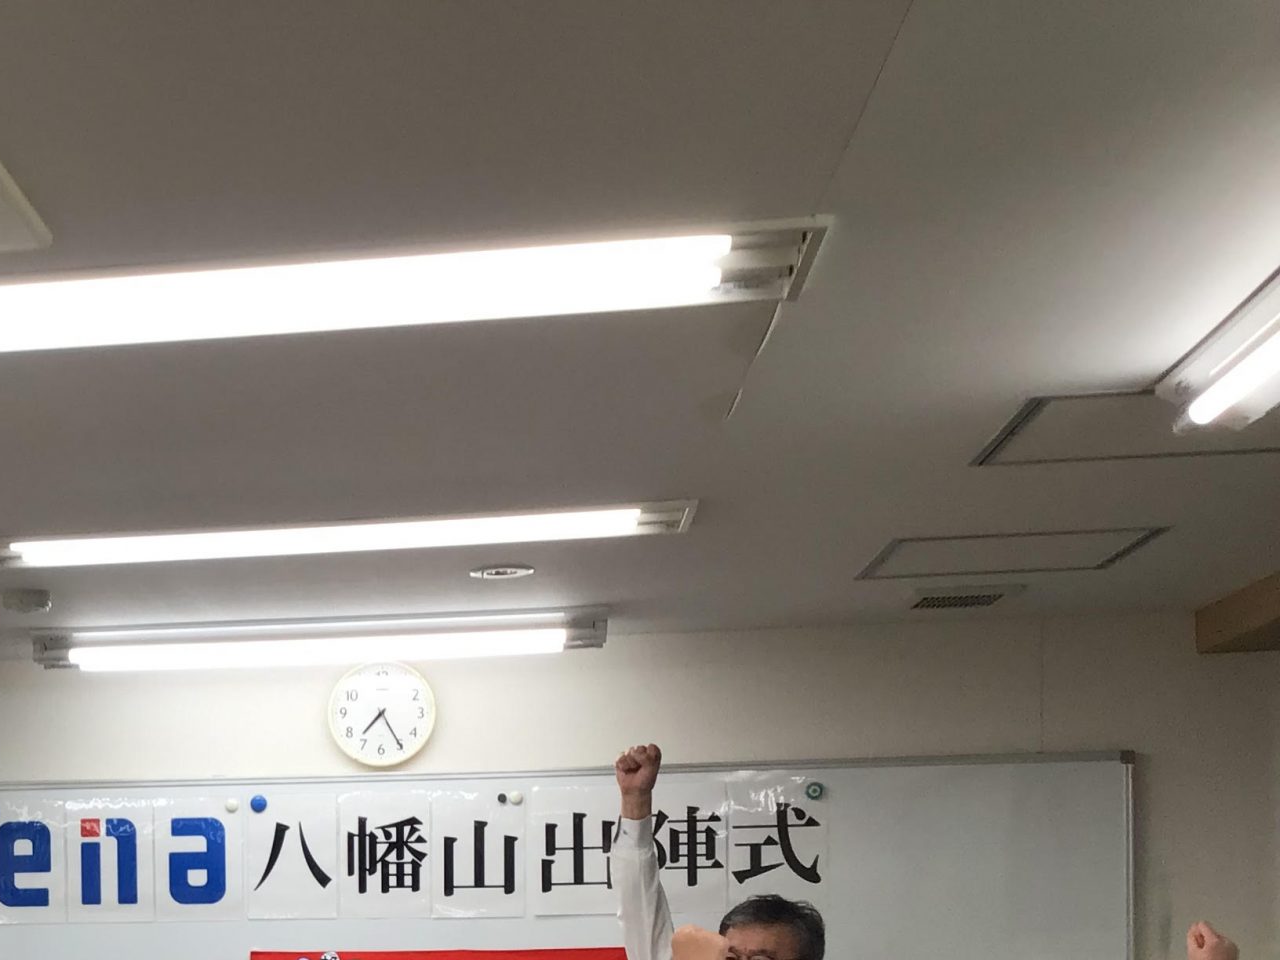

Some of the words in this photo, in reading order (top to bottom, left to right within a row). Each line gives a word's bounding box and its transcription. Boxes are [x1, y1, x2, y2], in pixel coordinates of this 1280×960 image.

[346, 689, 359, 701] 10
[412, 689, 420, 701] 2
[339, 707, 347, 719] 9
[417, 707, 425, 719] 3
[345, 726, 354, 739] 8
[409, 726, 418, 738] 4
[360, 738, 368, 751] 7
[377, 744, 386, 756] 6
